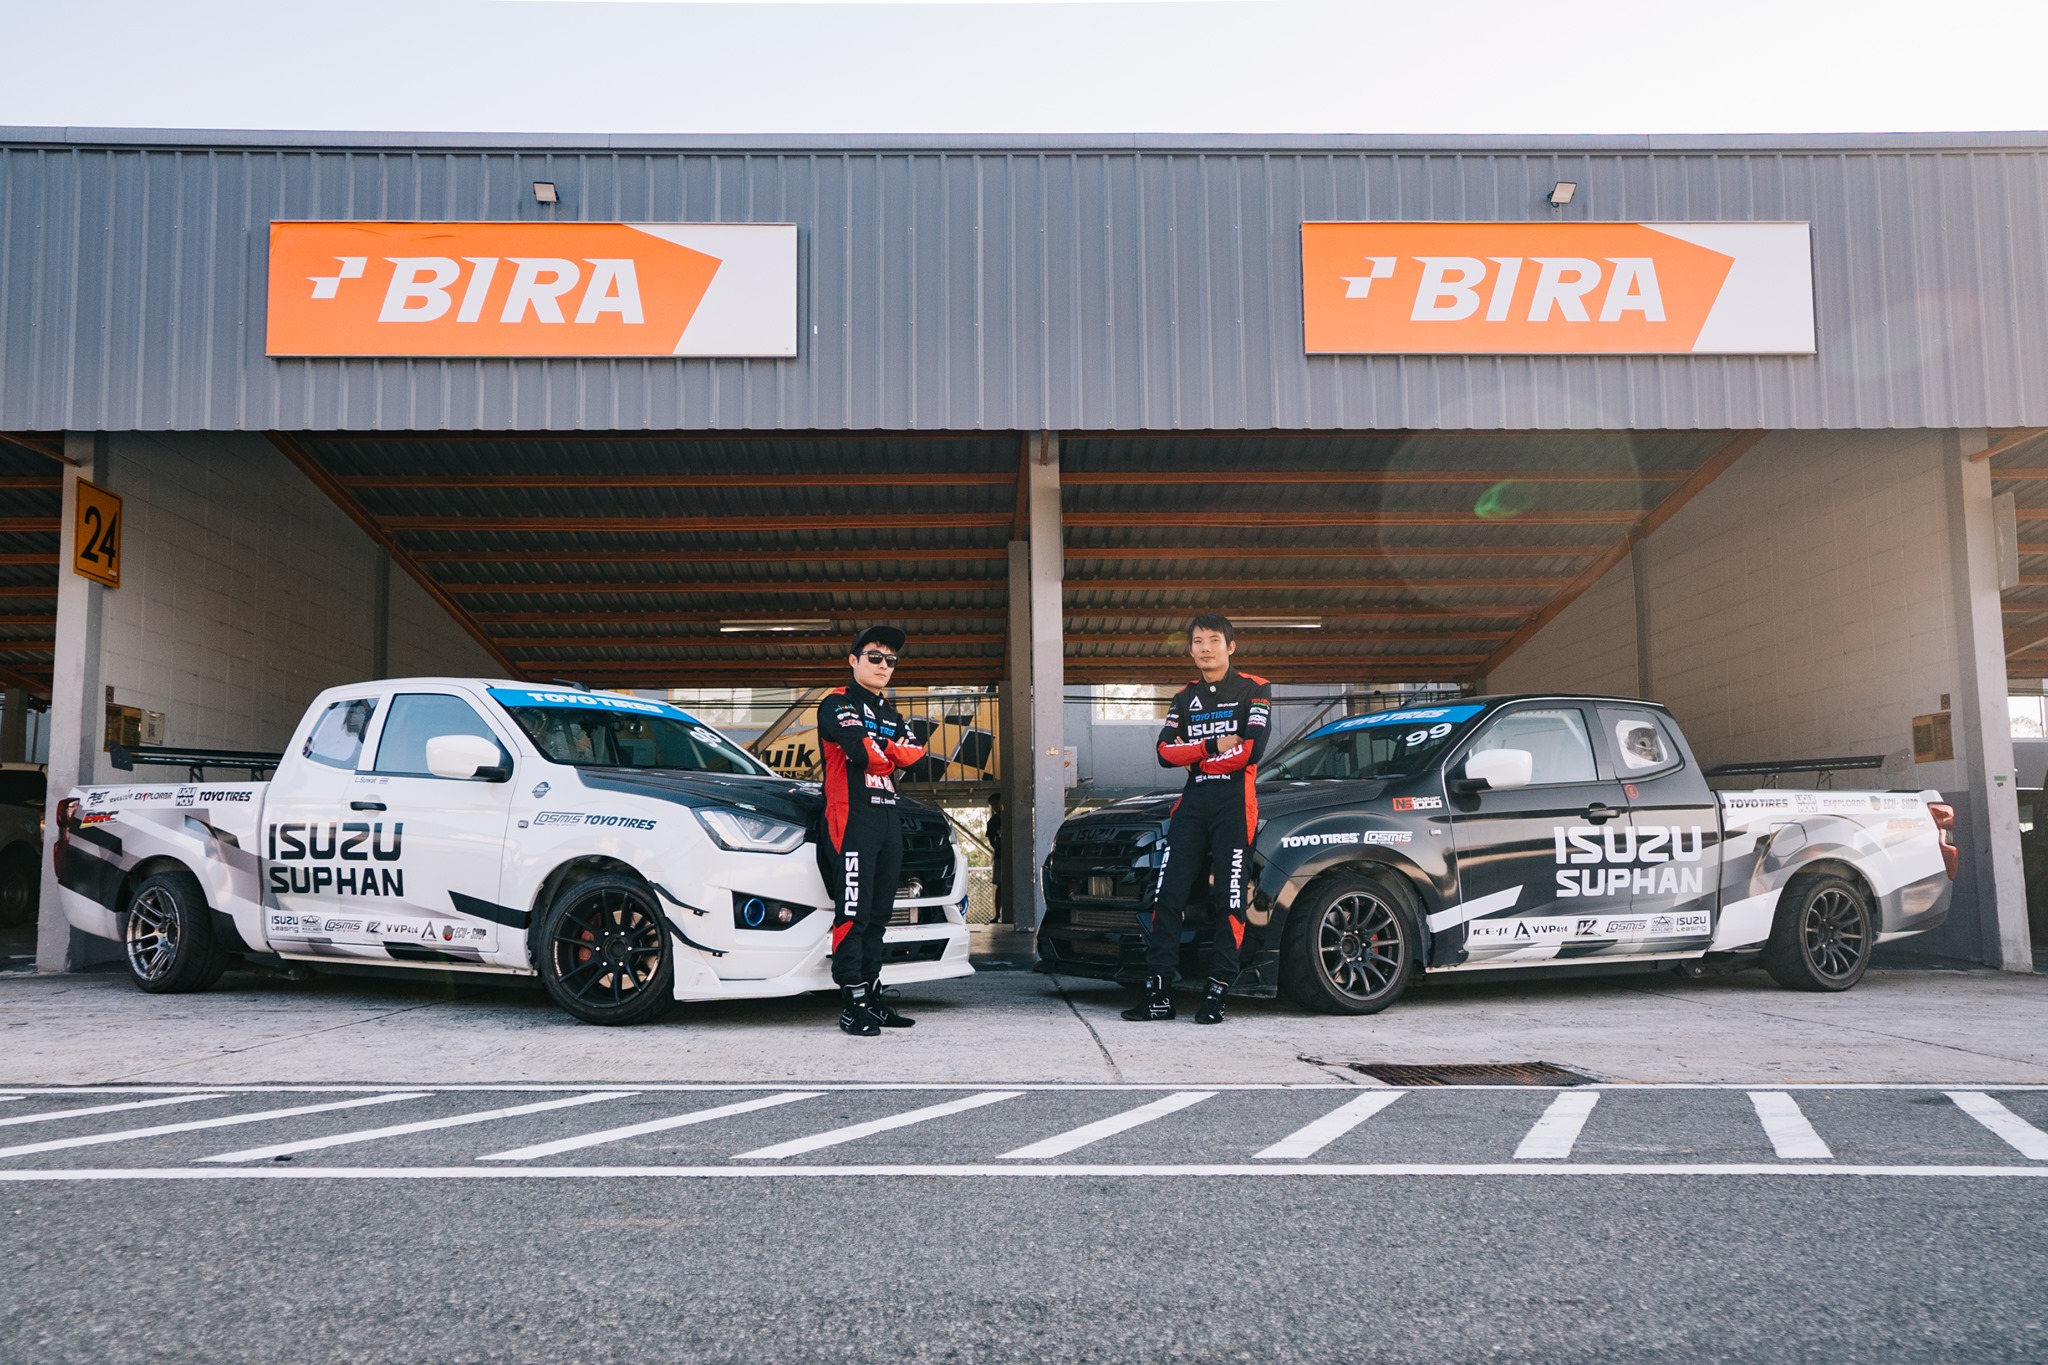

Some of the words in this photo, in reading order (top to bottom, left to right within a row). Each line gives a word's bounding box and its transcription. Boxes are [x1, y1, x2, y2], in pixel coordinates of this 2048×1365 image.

[378, 256, 645, 324] BIRA
[1410, 256, 1667, 322] BIRA
[81, 505, 117, 568] 24
[527, 692, 597, 705] TOYO
[596, 697, 664, 714] TIRES
[1190, 713, 1210, 722] TOYO
[1210, 710, 1233, 720] TIRES
[1334, 713, 1388, 730] TOYO
[1386, 709, 1451, 721] TIRES
[1187, 720, 1238, 737] ISUZU
[1405, 723, 1452, 747] 99
[763, 744, 815, 768] uik
[199, 791, 225, 802] TOYO
[225, 791, 253, 802] TIRES
[1729, 799, 1758, 809] TOYO
[1758, 798, 1788, 808] TIRES
[584, 815, 618, 826] TOYO
[617, 817, 657, 830] TIRES
[269, 822, 404, 861] ISUZU
[1076, 828, 1116, 841] ISUZU
[1281, 834, 1320, 848] TOYO
[1320, 833, 1358, 845] TIRES
[1553, 826, 1703, 864] ISUZU
[269, 867, 404, 897] SUPHAN
[844, 851, 859, 917] ISUZU
[1230, 848, 1243, 909] SUPHAN
[1555, 867, 1703, 897] SUPHAN
[271, 915, 299, 925] ISUZU
[271, 925, 299, 934] Leasing
[1676, 916, 1707, 926] ISUZU
